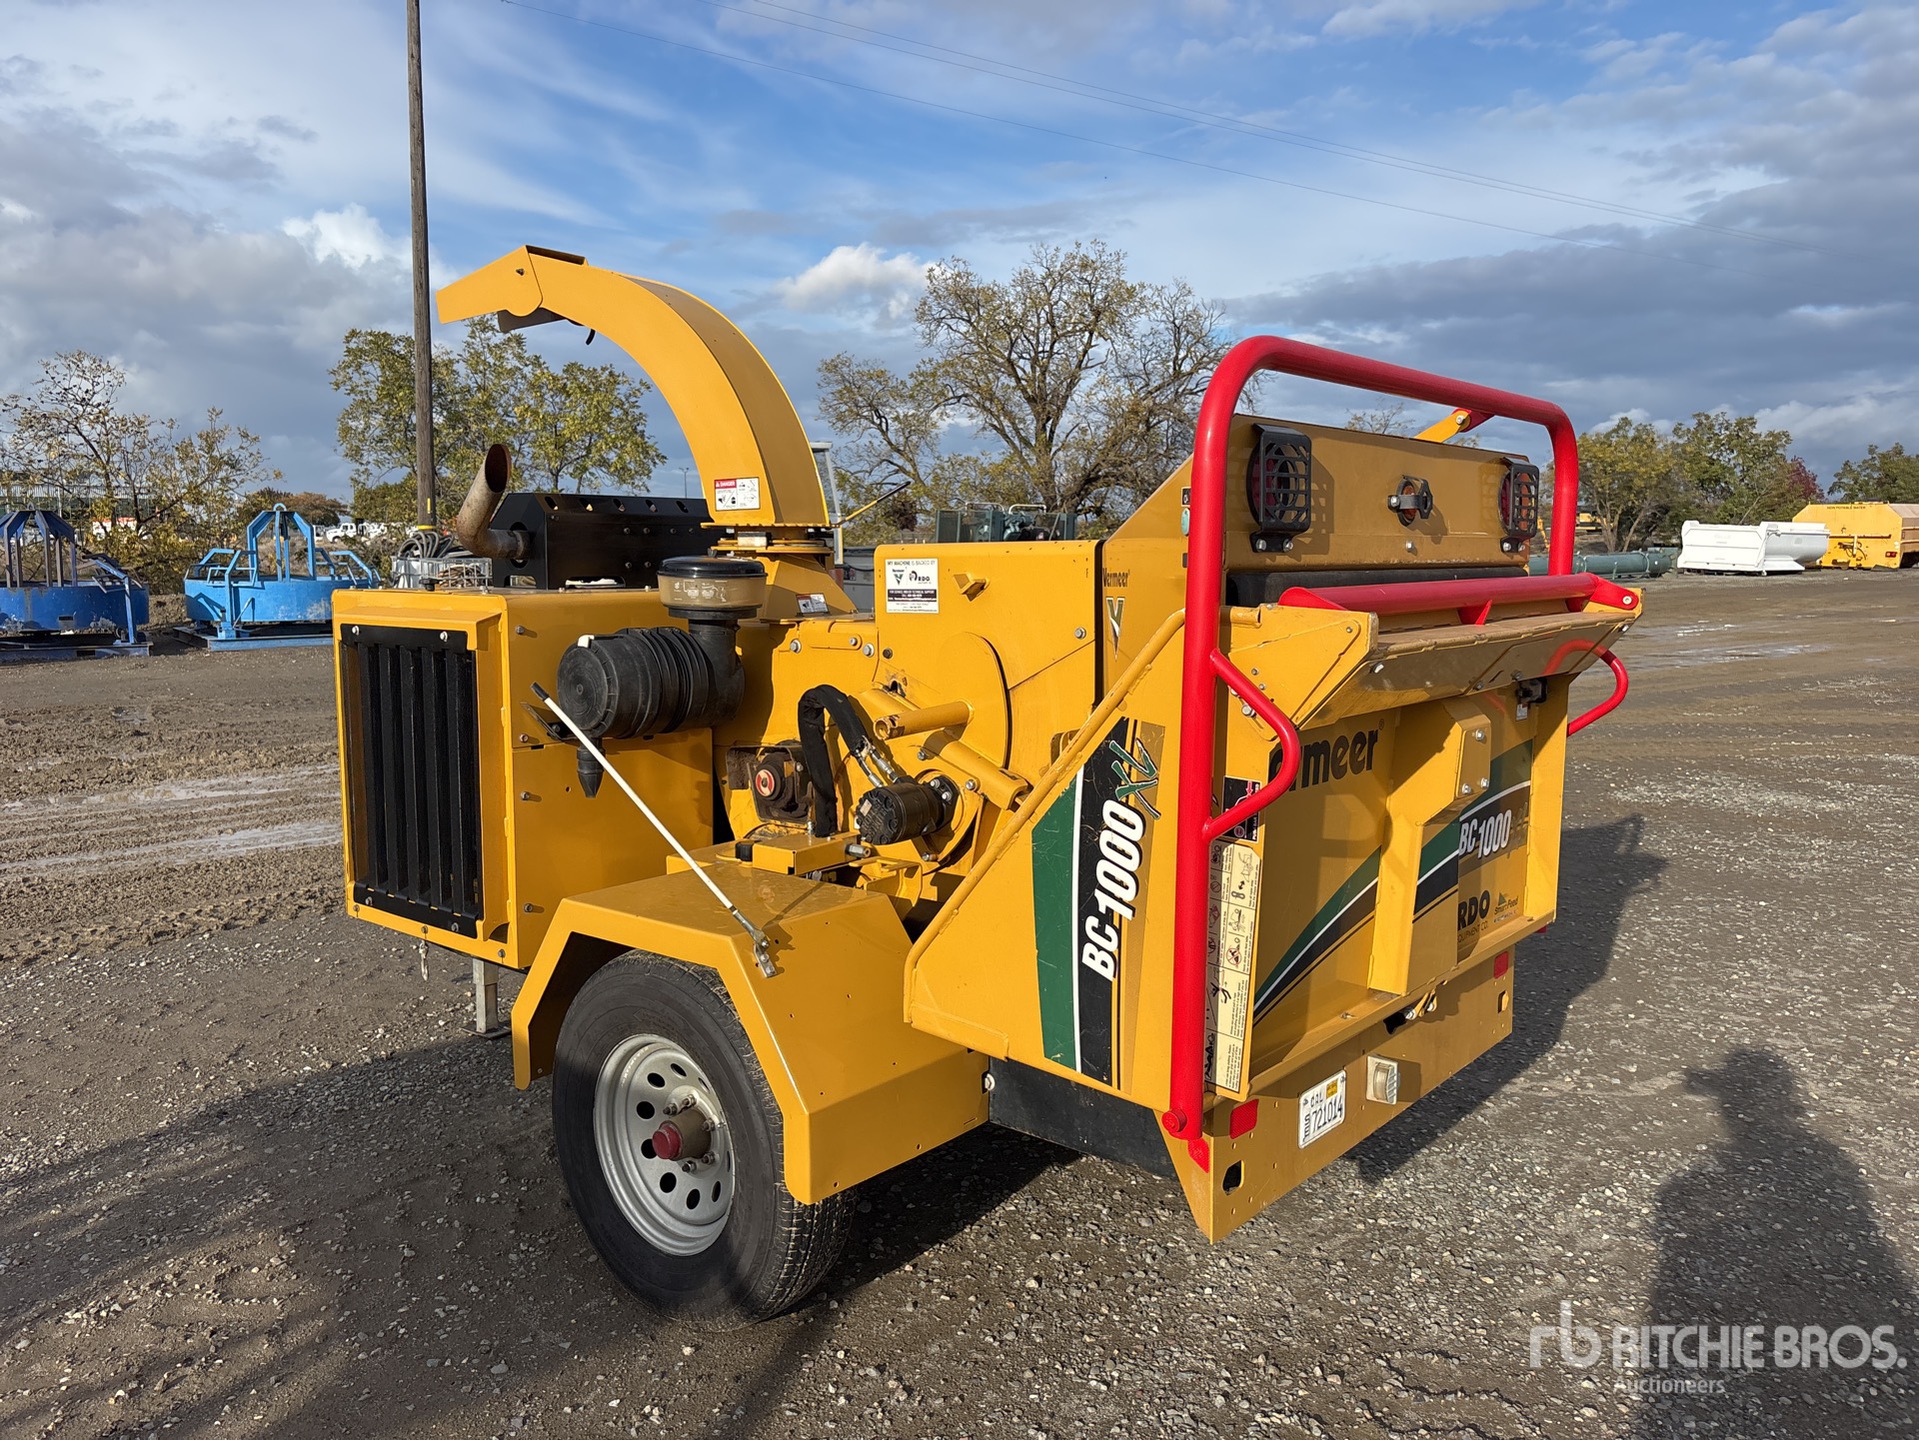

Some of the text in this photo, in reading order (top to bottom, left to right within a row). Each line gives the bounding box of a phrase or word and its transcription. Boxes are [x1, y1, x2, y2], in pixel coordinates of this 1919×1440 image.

[1459, 818, 1478, 856] BC
[1478, 809, 1512, 858] 1000
[1094, 799, 1145, 922] 1000
[1458, 890, 1490, 931] RDO
[1081, 915, 1120, 982] BC
[1312, 1097, 1343, 1134] 721014
